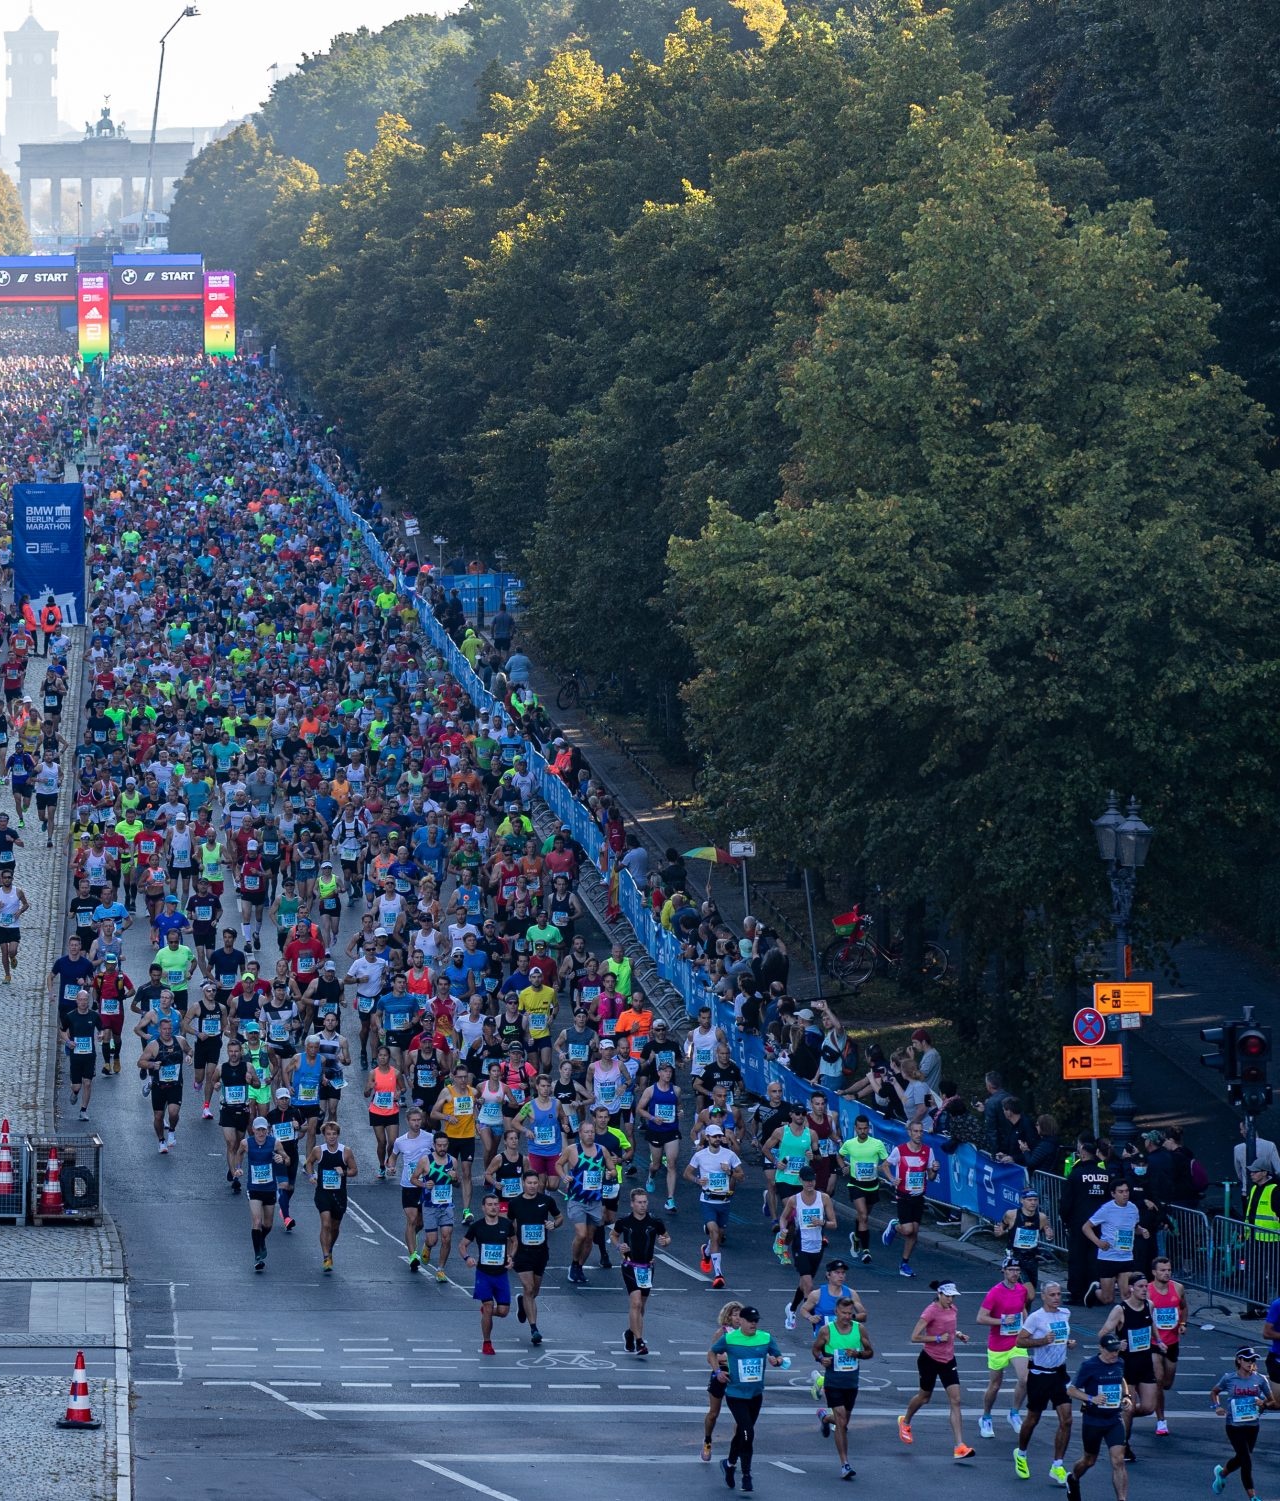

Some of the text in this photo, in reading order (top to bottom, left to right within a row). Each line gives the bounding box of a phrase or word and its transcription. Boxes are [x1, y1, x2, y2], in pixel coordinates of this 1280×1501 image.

[34, 273, 68, 282] START
[161, 272, 195, 281] START
[26, 506, 53, 516] BMW
[742, 1365, 761, 1374] 15215
